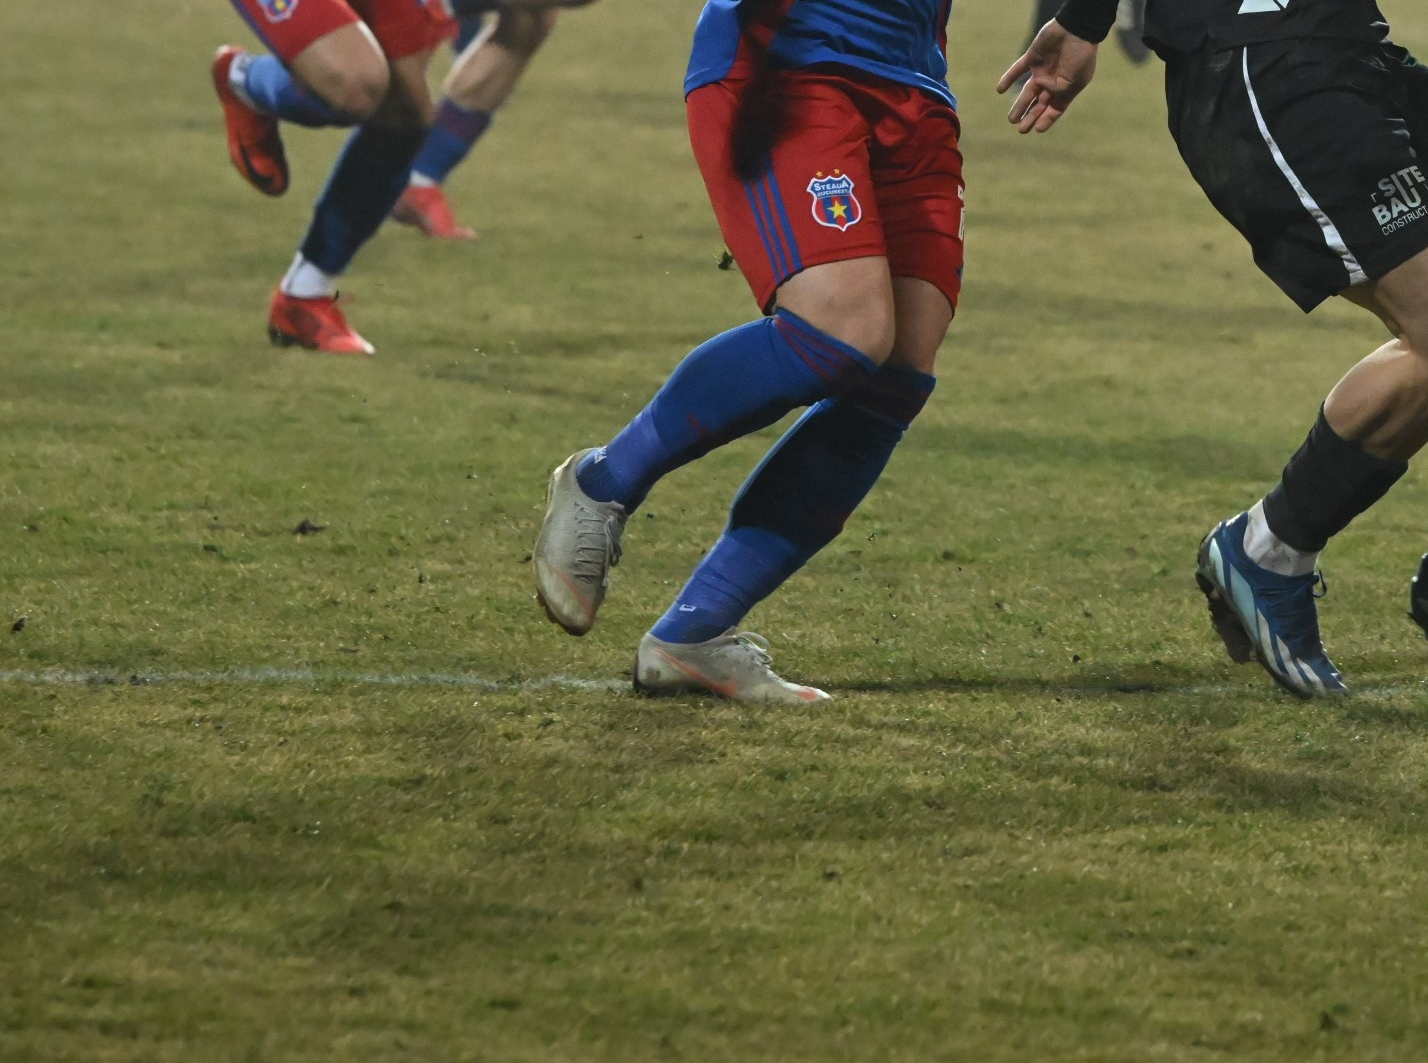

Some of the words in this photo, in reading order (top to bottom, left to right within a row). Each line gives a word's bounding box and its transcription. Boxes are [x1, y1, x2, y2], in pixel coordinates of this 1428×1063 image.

[814, 180, 849, 191] STEAUA
[1378, 165, 1425, 197] SITE
[1372, 187, 1421, 225] BAU
